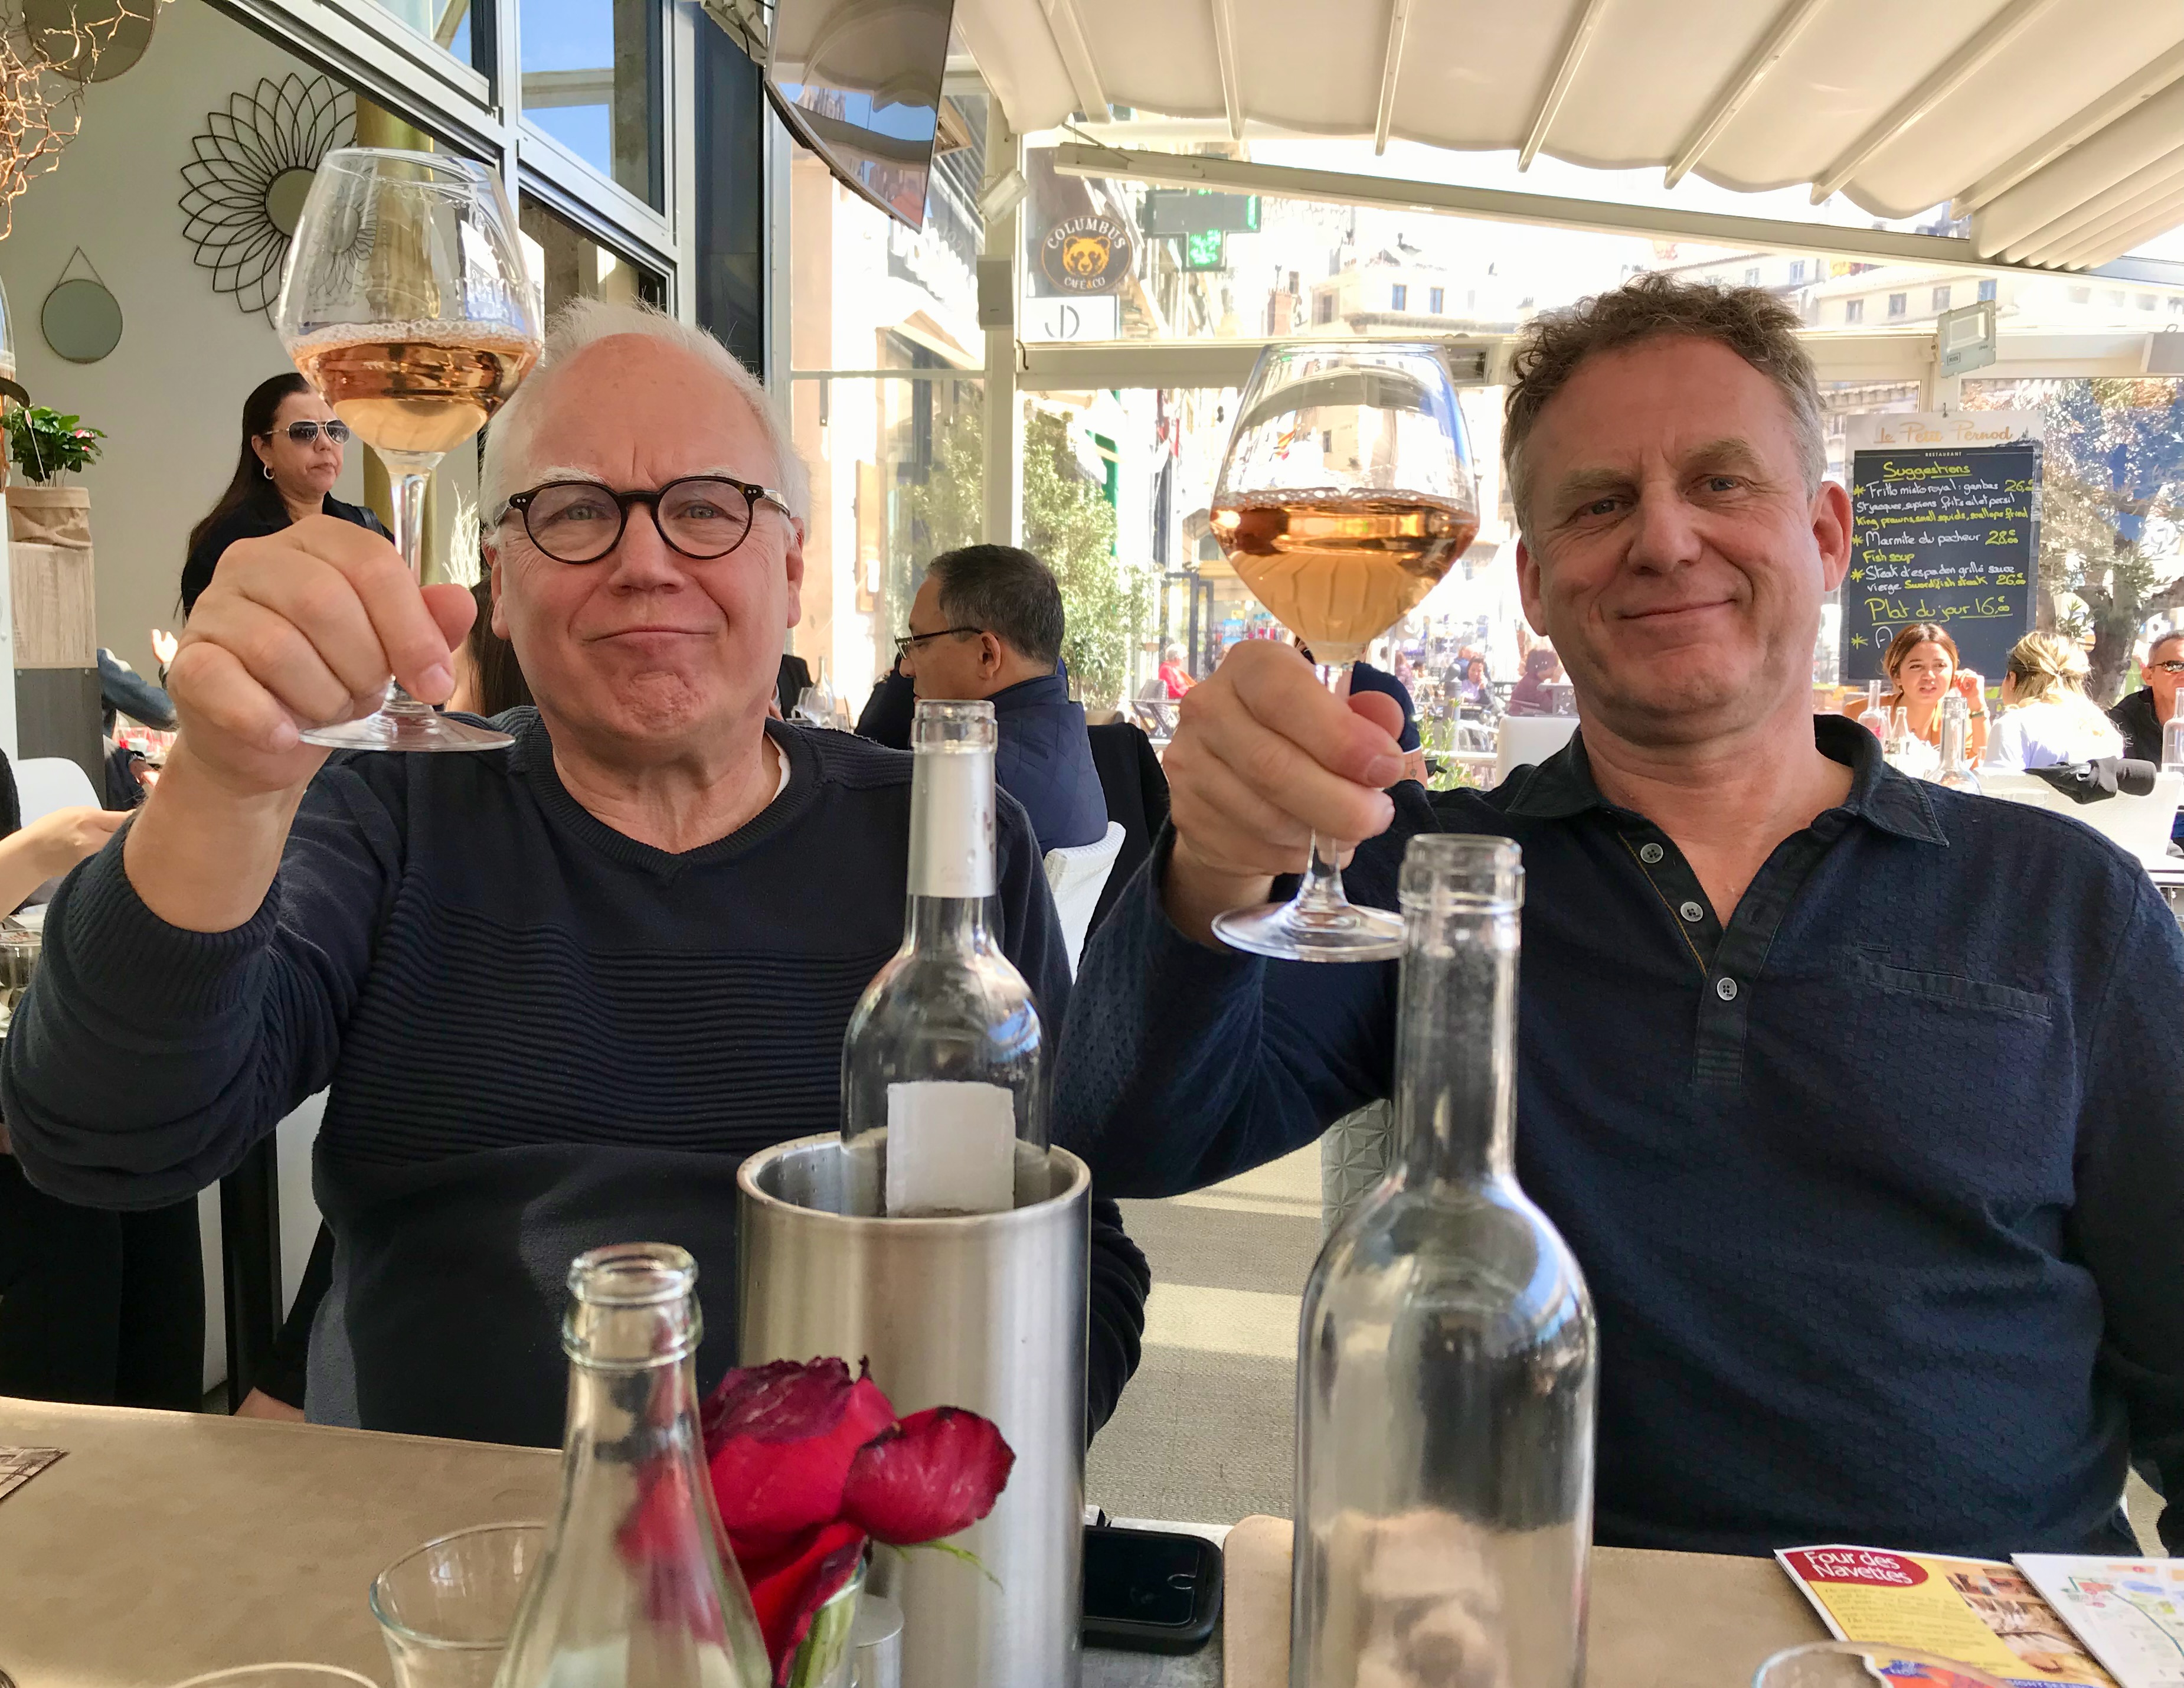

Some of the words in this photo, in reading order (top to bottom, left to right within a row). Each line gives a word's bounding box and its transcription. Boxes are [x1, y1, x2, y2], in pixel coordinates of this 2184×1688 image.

[1047, 218, 1126, 249] COLUMBUS
[1875, 427, 1895, 443] Le
[1899, 422, 1943, 442] Petit
[1950, 420, 2013, 440] Pernod
[1883, 461, 1971, 481] Suggestions
[1866, 481, 1898, 498] Fritto
[1900, 482, 1927, 495] misto
[1963, 478, 1999, 495] gambas
[1856, 516, 1879, 531] King
[2005, 507, 2028, 521] fried
[1866, 531, 1915, 547] Marmite
[1918, 531, 1935, 544] du
[1862, 549, 1887, 563] Fish
[1889, 553, 1915, 564] soup
[1865, 564, 1899, 580] Steak
[1988, 565, 2015, 574] sauce
[1866, 582, 1902, 595] vierge
[1864, 598, 1910, 621] Plat
[1915, 599, 1935, 618] du
[1938, 605, 1970, 623] jour
[1803, 1551, 1855, 1565] Four
[1860, 1552, 1901, 1570] des
[1812, 1562, 1913, 1584] Navettes
